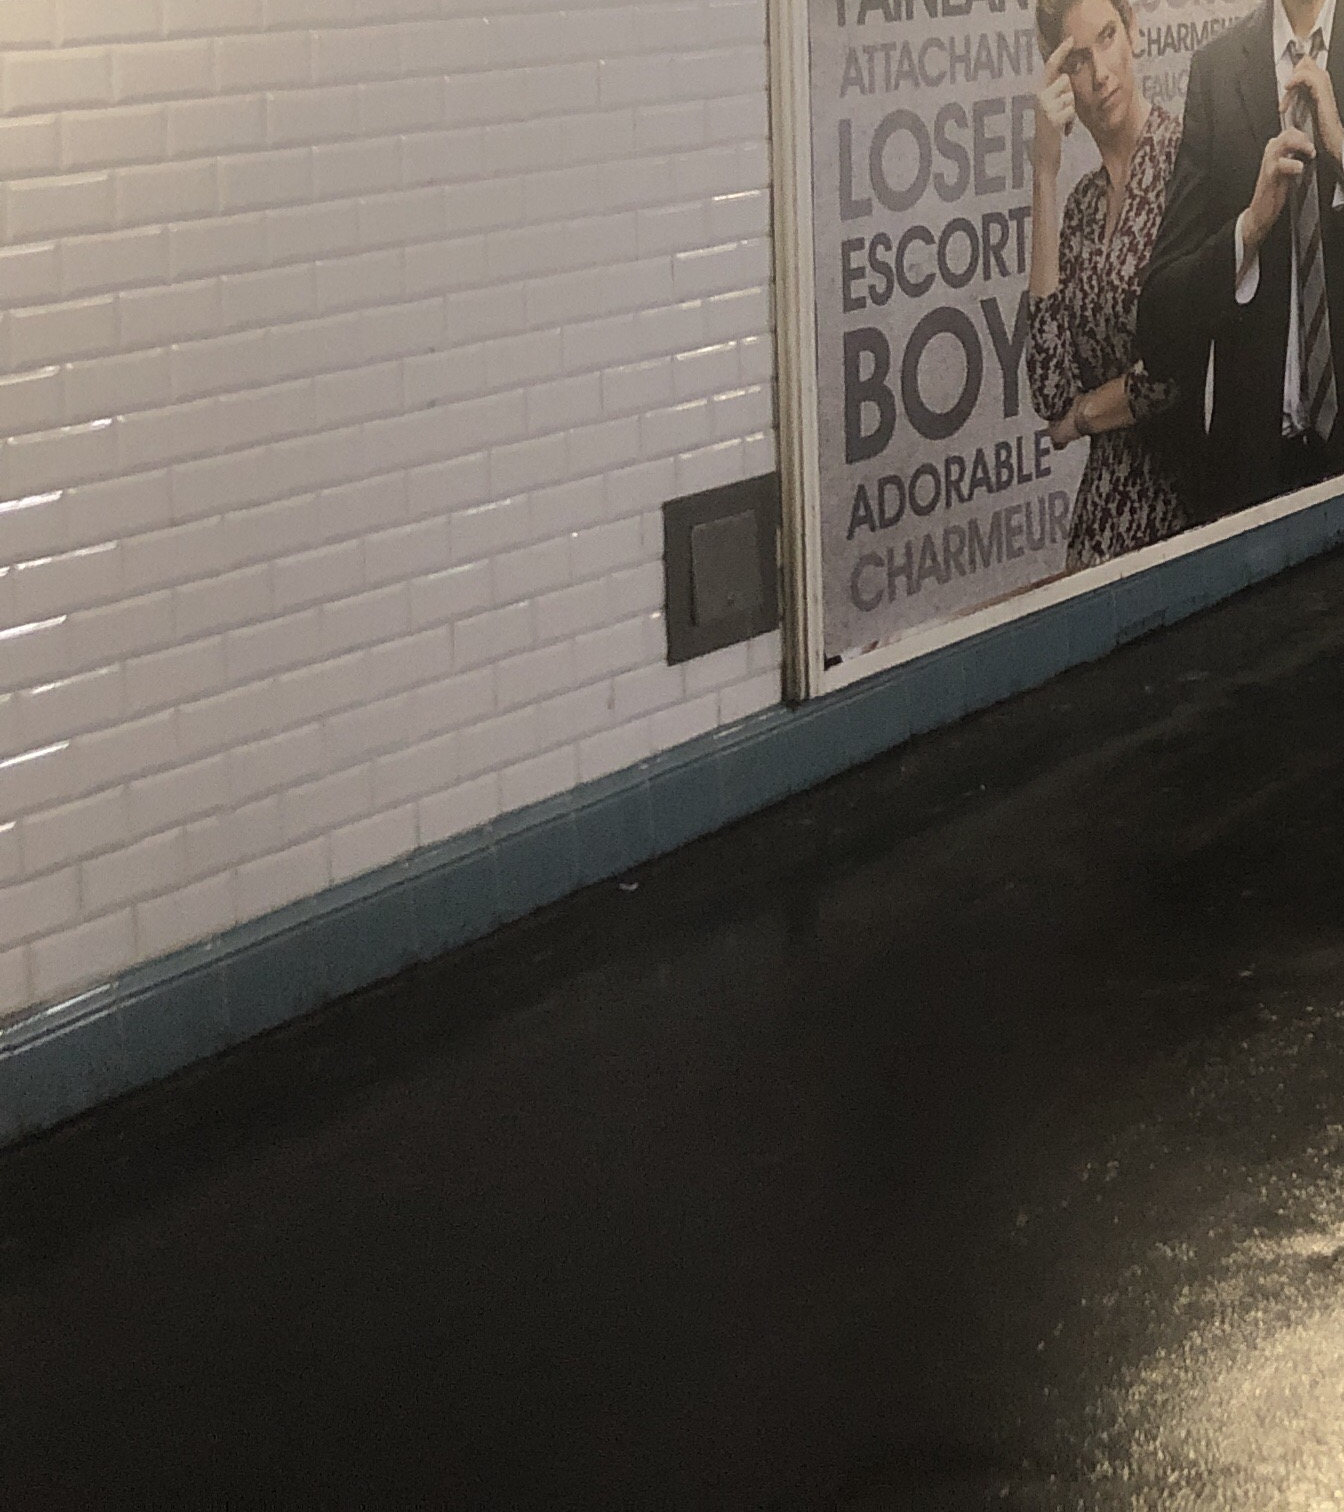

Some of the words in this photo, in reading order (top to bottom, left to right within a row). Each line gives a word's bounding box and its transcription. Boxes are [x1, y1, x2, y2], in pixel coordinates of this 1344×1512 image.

[840, 205, 1032, 314] ESCORT
[843, 289, 1033, 465] BOY
[846, 428, 1052, 540] ADORABLE
[850, 489, 1071, 614] CHARMEUR
